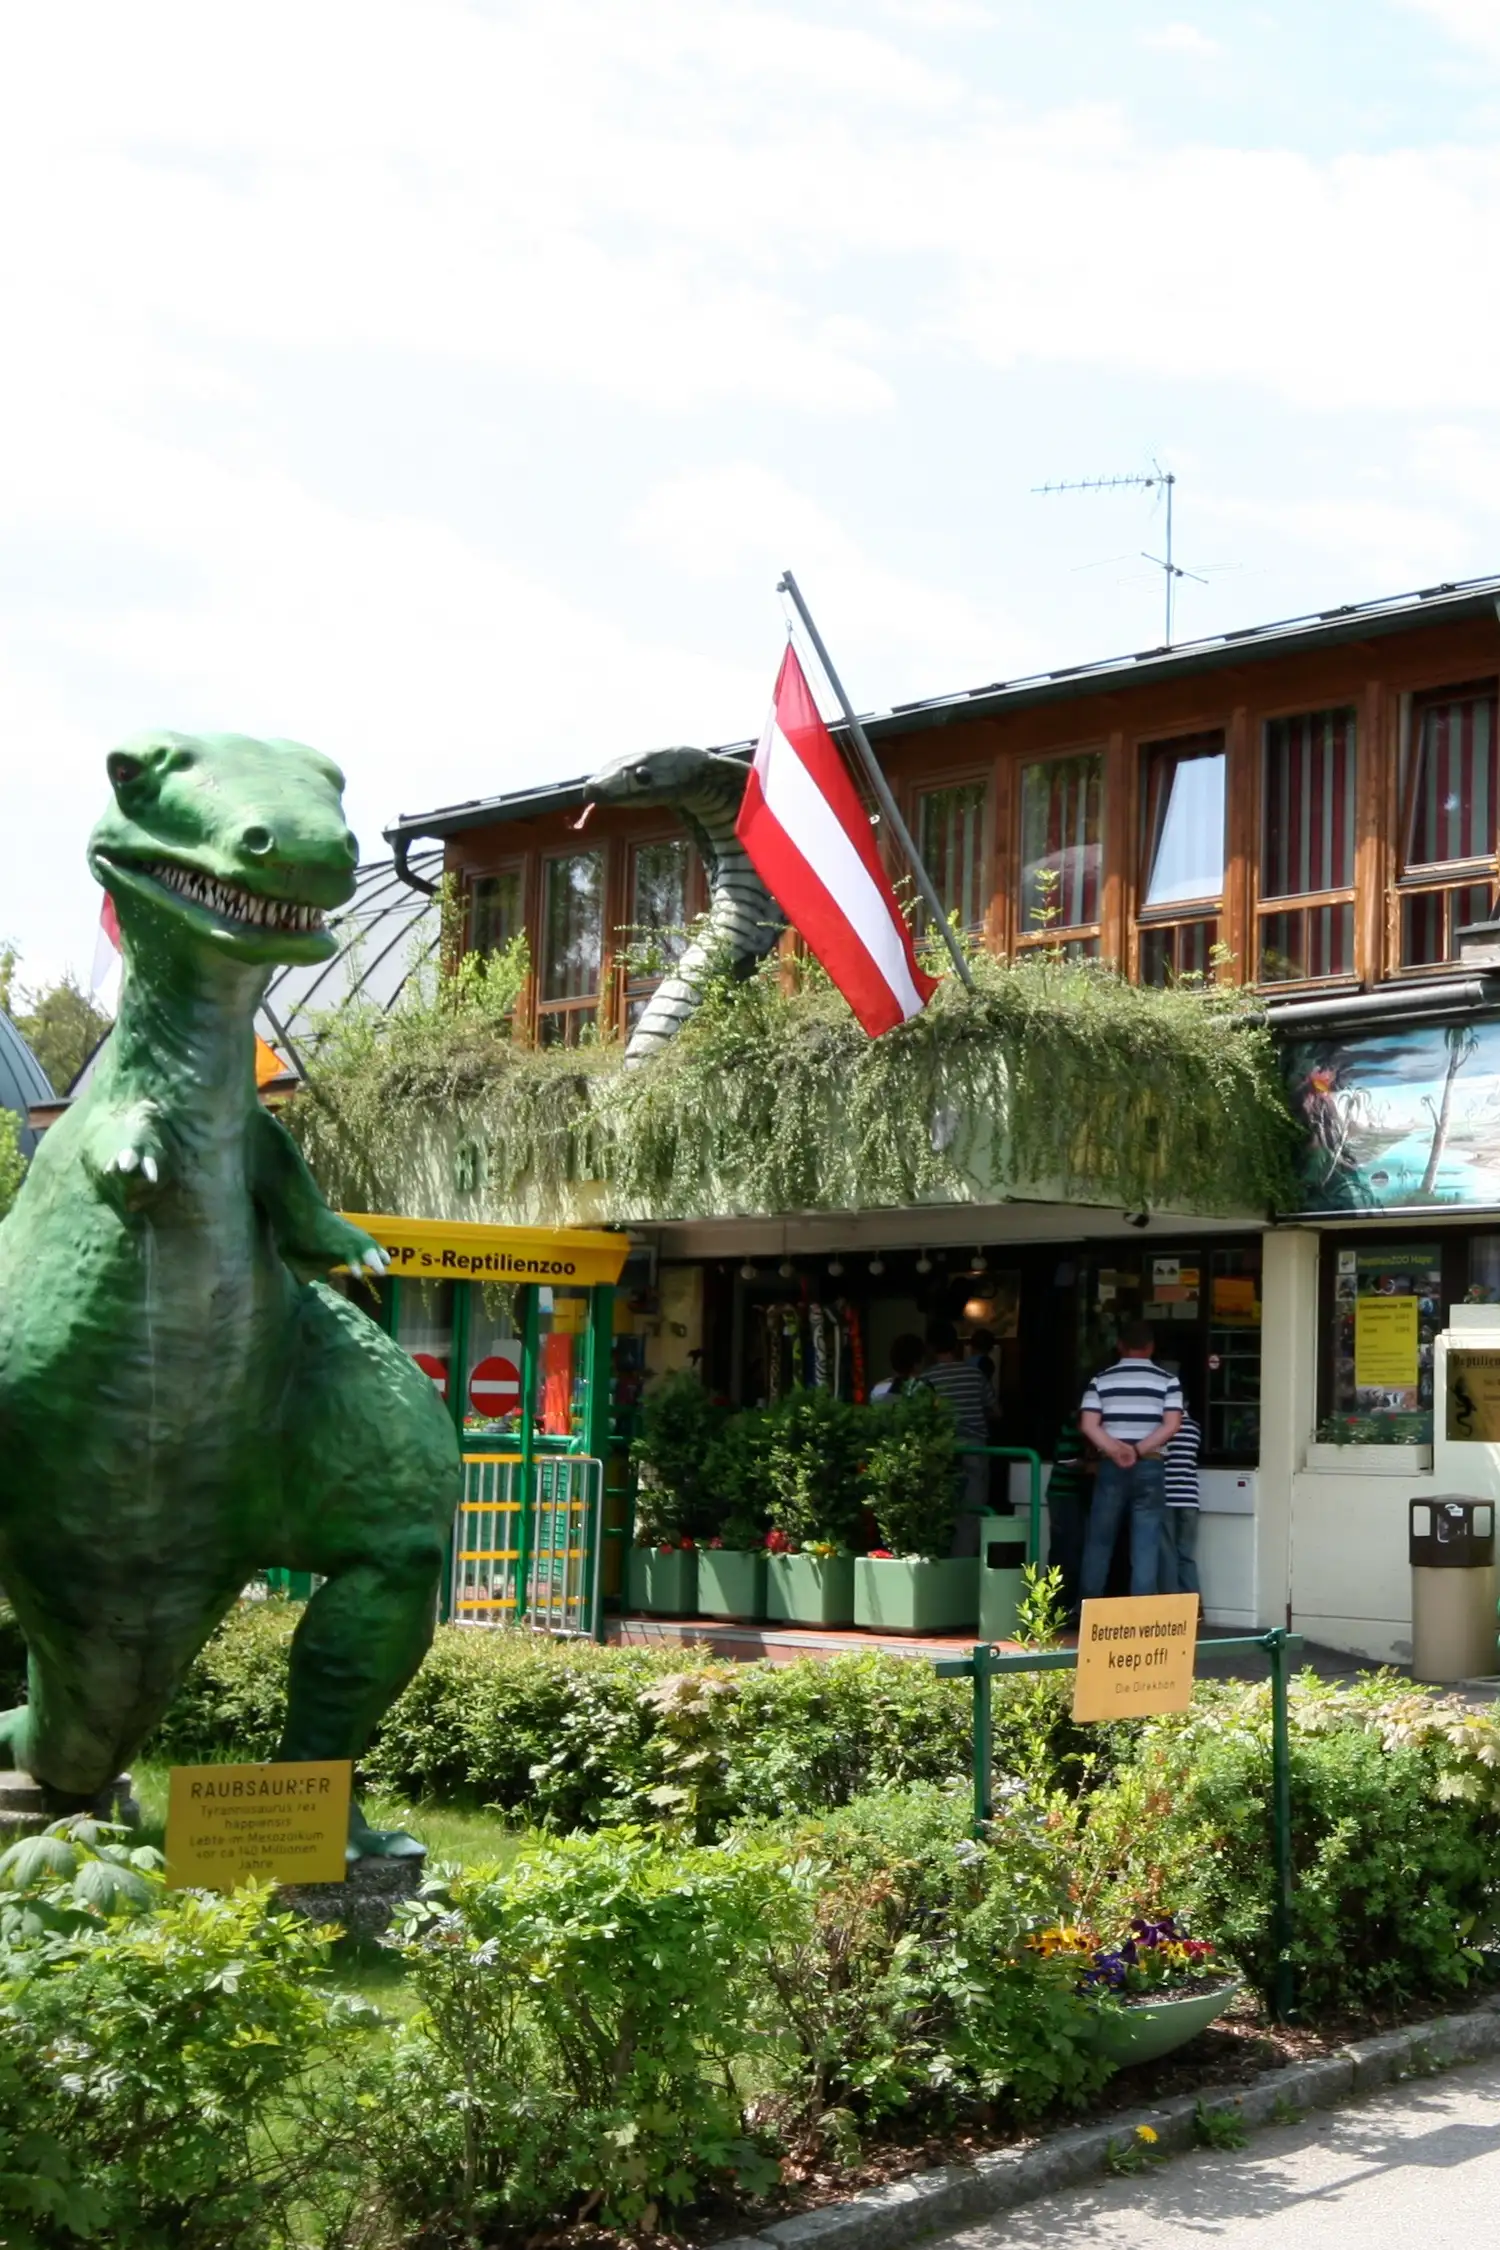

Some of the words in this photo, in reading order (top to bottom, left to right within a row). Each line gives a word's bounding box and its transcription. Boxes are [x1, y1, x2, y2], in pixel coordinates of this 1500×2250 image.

[1091, 1623, 1136, 1642] Betreten
[1139, 1620, 1187, 1639] verboten!
[1108, 1650, 1141, 1671] keep
[1145, 1648, 1168, 1667] off!
[190, 1777, 331, 1800] RAUBSAURIER
[261, 1843, 317, 1856] Millionen
[238, 1858, 274, 1871] Jahre
